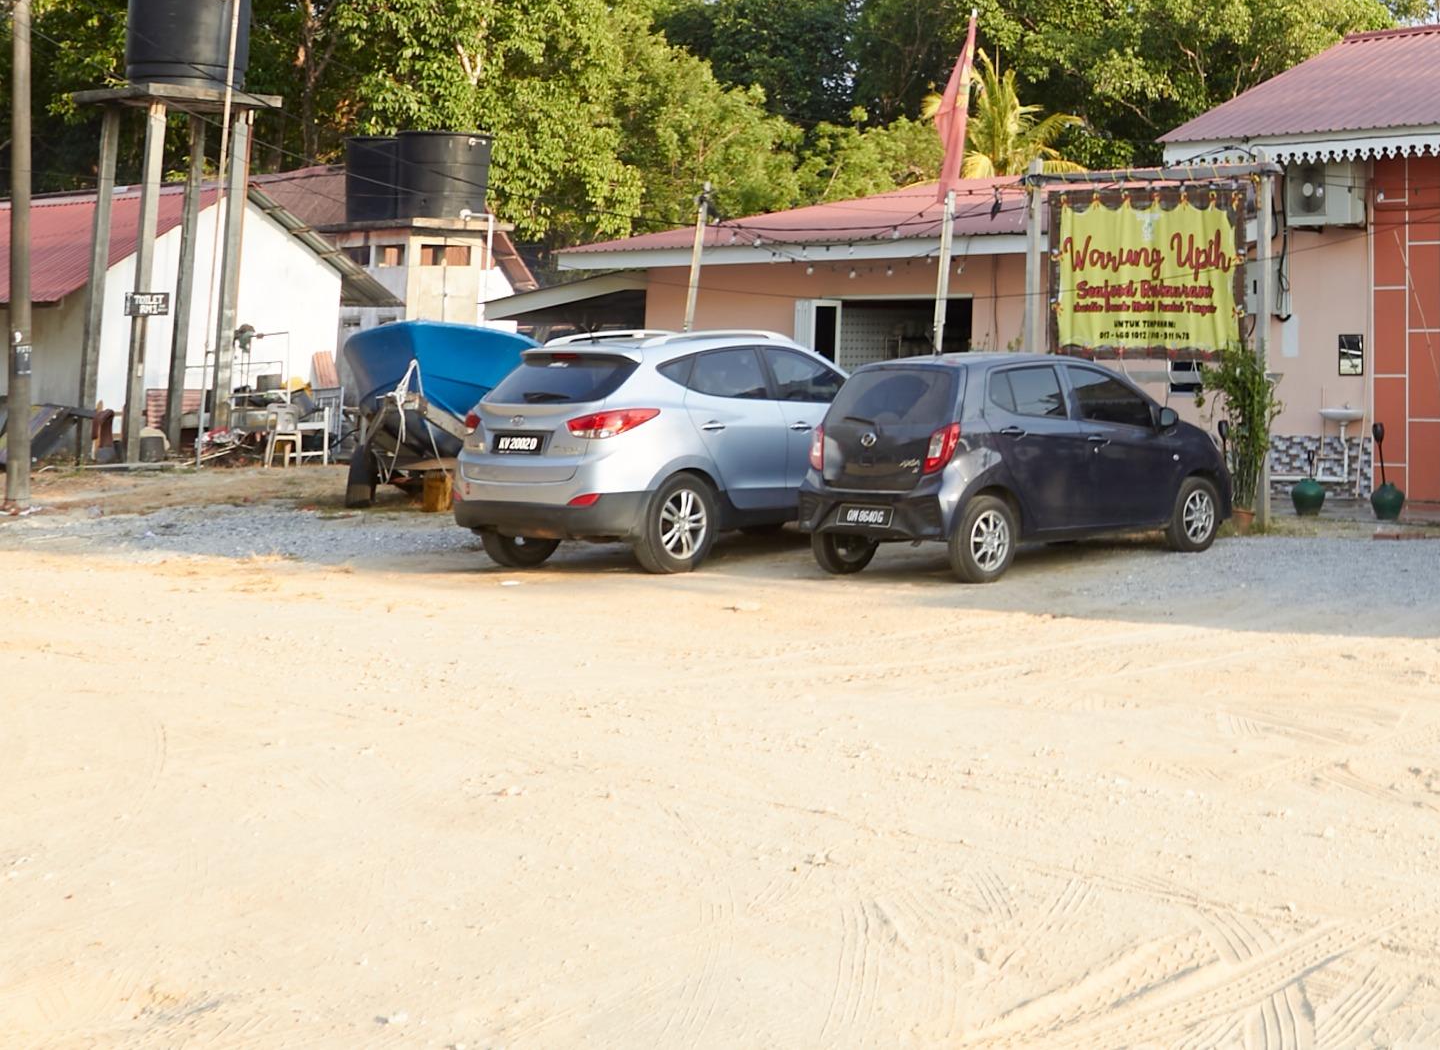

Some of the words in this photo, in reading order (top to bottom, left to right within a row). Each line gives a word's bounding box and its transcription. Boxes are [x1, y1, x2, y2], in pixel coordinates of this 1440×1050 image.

[1063, 236, 1165, 280] Warung
[1170, 229, 1231, 282] Upih
[133, 294, 164, 305] TOILET
[139, 304, 158, 314] RM1
